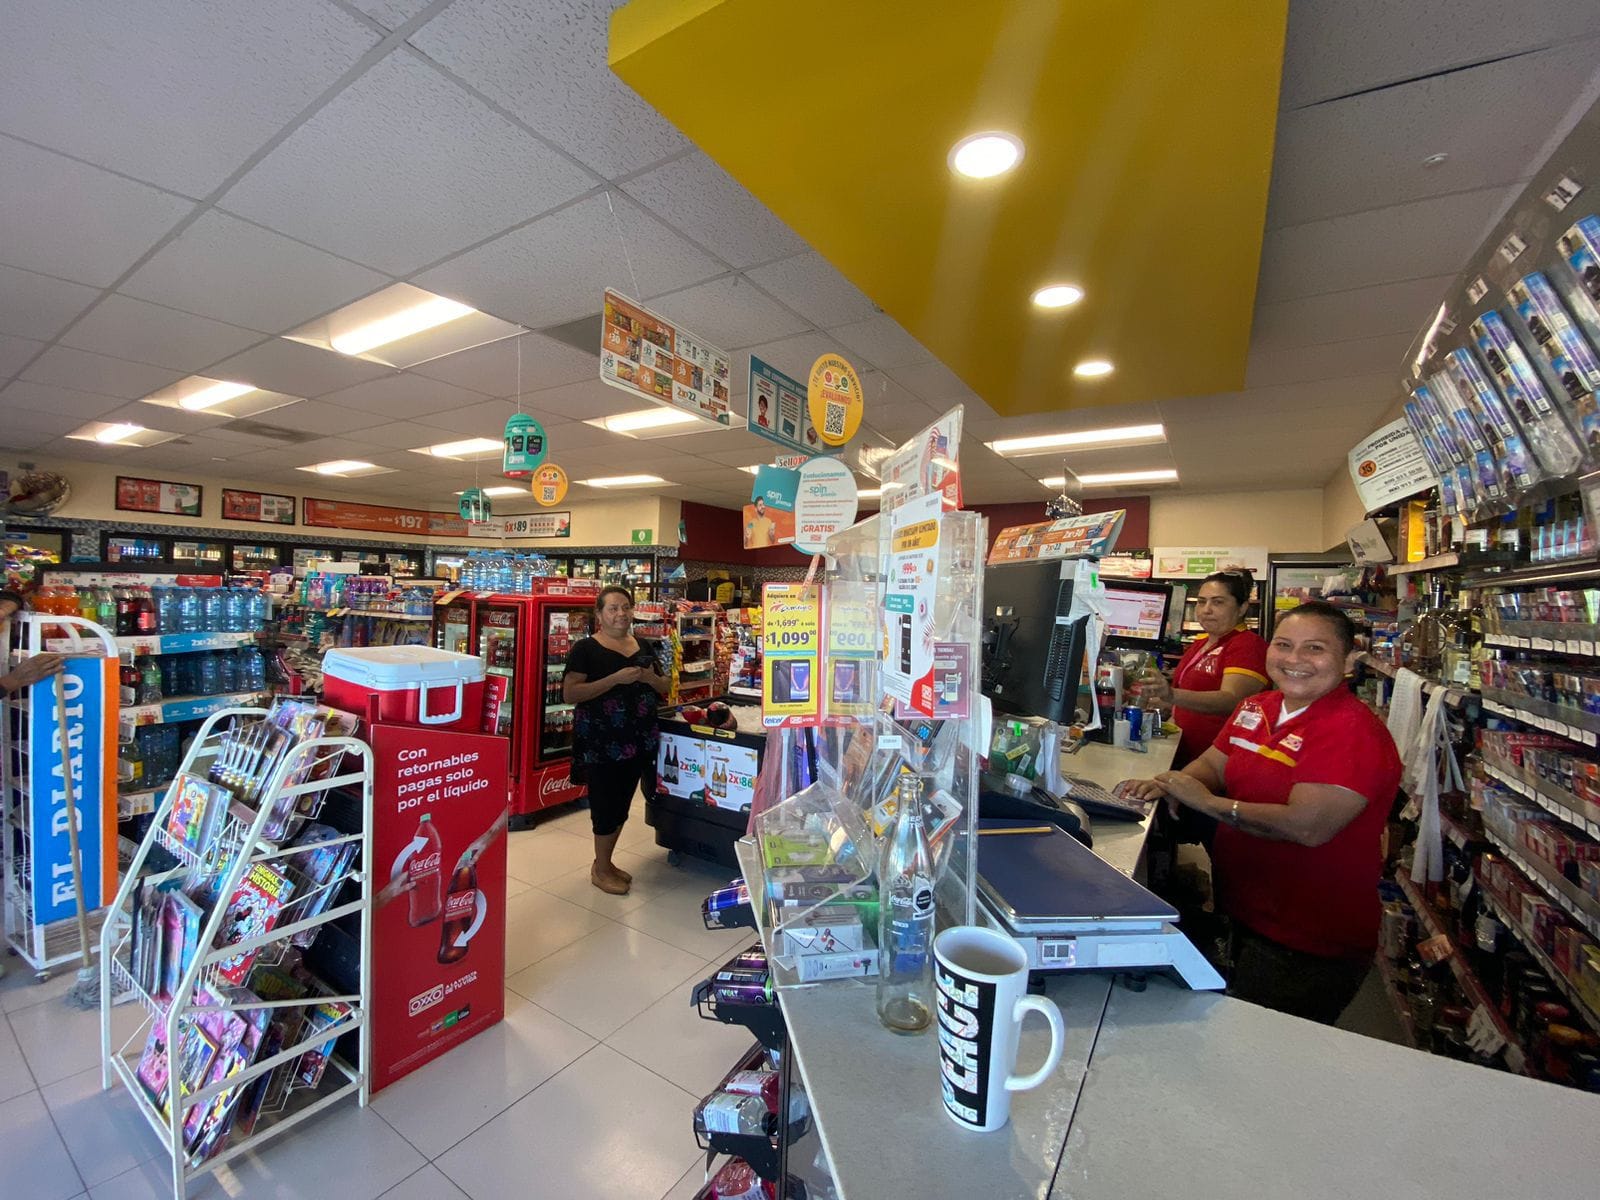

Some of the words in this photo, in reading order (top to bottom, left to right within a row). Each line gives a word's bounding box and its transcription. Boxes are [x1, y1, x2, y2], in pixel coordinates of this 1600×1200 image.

[1388, 430, 1411, 443] UNIDA
[767, 490, 782, 502] spin
[395, 514, 423, 528] $197
[801, 524, 835, 534] ¡GRATIS!
[52, 673, 84, 837] DIARIO
[398, 748, 427, 761] Con
[398, 752, 479, 778] retornables
[398, 776, 442, 796] pagas
[445, 768, 474, 782] solo
[398, 796, 423, 813] por
[426, 790, 440, 802] el
[443, 779, 489, 798] líquido
[52, 849, 83, 908] EL
[410, 988, 443, 1012] OXXO
[721, 989, 739, 997] VOLT
[935, 960, 979, 1123] PEACE
